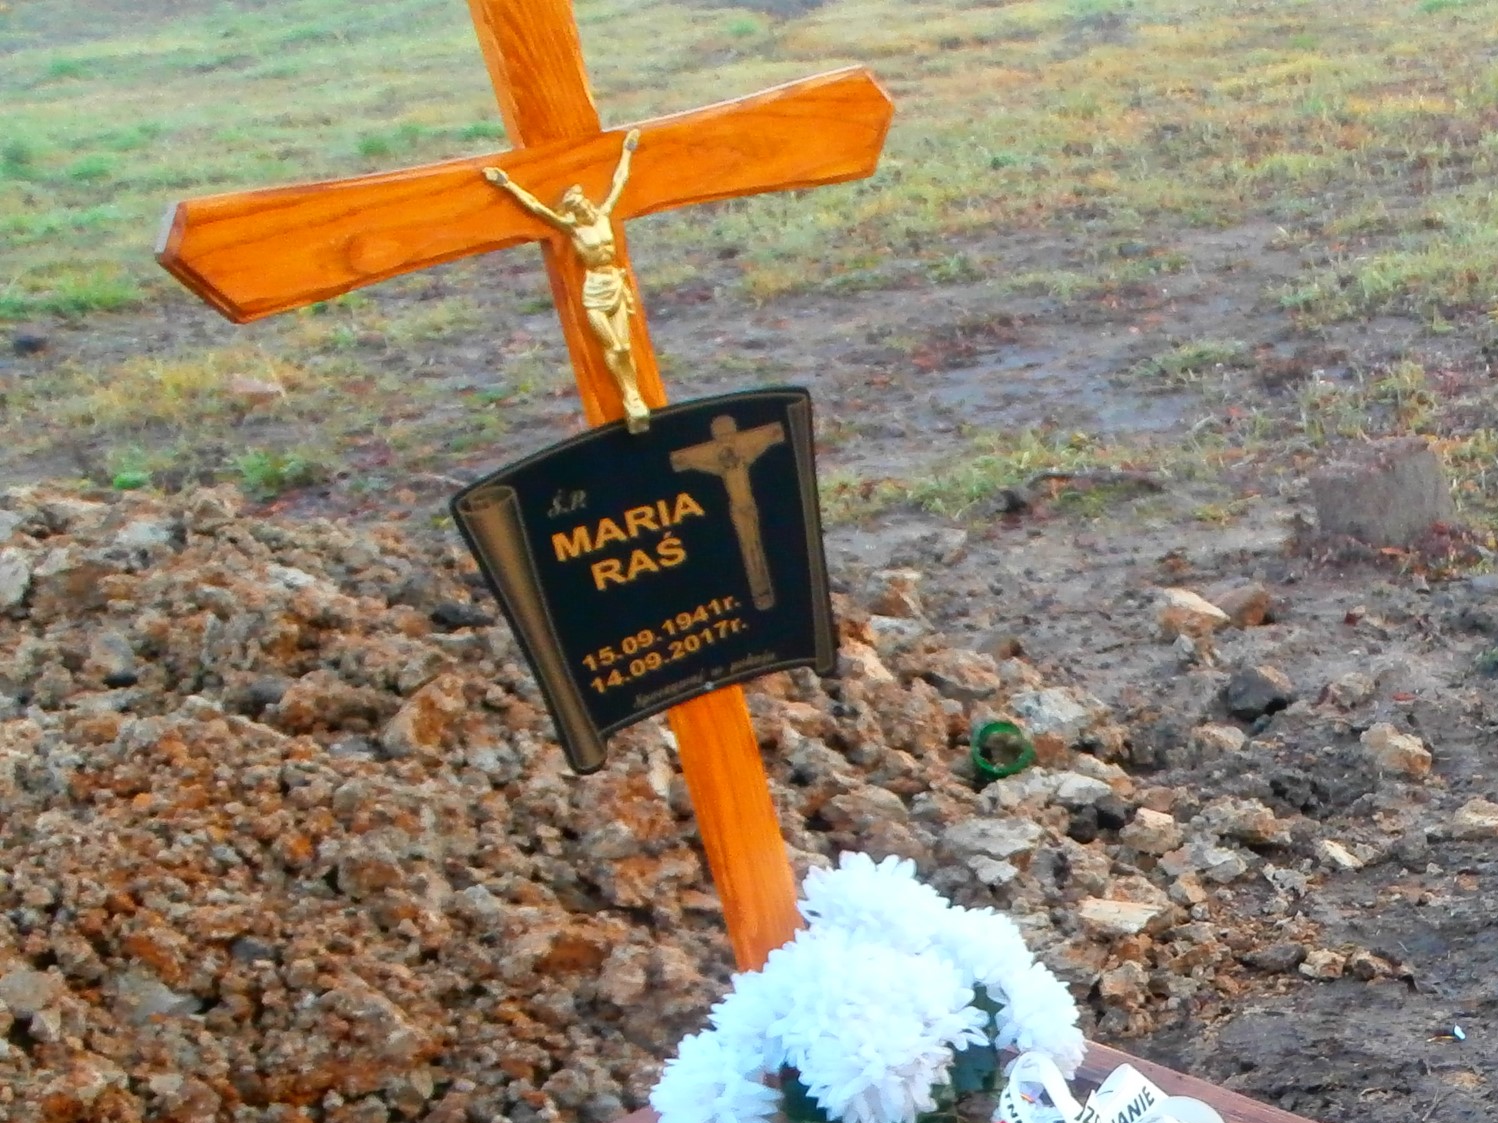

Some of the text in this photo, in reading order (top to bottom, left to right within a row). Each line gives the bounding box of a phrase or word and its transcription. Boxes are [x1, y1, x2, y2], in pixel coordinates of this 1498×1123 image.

[551, 491, 705, 562] MARIA
[590, 530, 687, 591] RAŚ
[582, 595, 742, 672] 15.09.1941r.
[590, 617, 749, 694] 14.09.2017r.
